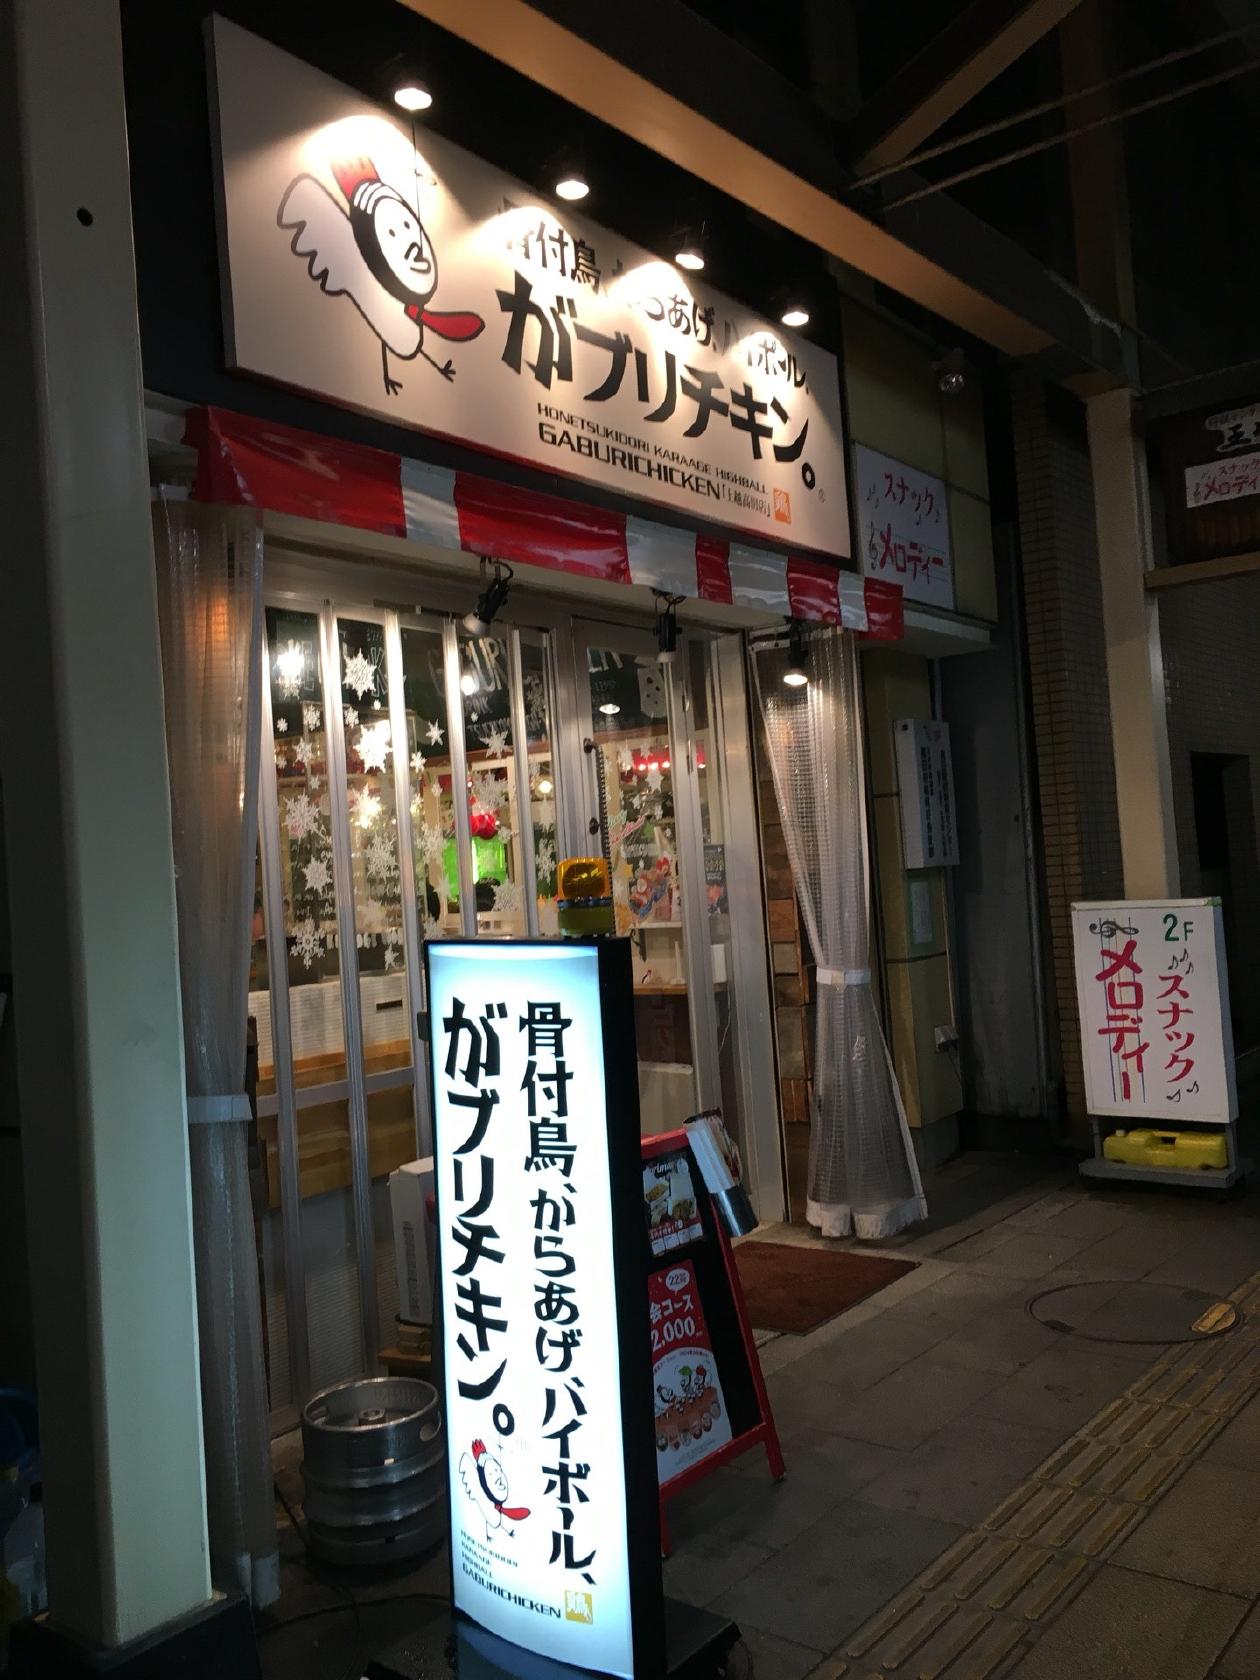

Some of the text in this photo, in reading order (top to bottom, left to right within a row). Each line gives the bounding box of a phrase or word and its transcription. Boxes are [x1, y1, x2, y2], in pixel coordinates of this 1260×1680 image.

[495, 270, 816, 490] がブリチキン。
[537, 402, 769, 495] HONETSUKIDORI KARAAGE HIGHBALL
[538, 422, 721, 500] GABURICHICKEN
[884, 471, 934, 517] スナック
[879, 523, 944, 585] メロディー
[1162, 913, 1195, 942] 2F
[1095, 939, 1150, 1100] メロディー
[1155, 974, 1196, 1083] スナック
[442, 996, 515, 1437] がブリチキン。
[462, 1562, 562, 1619] GABURICHICKEN
